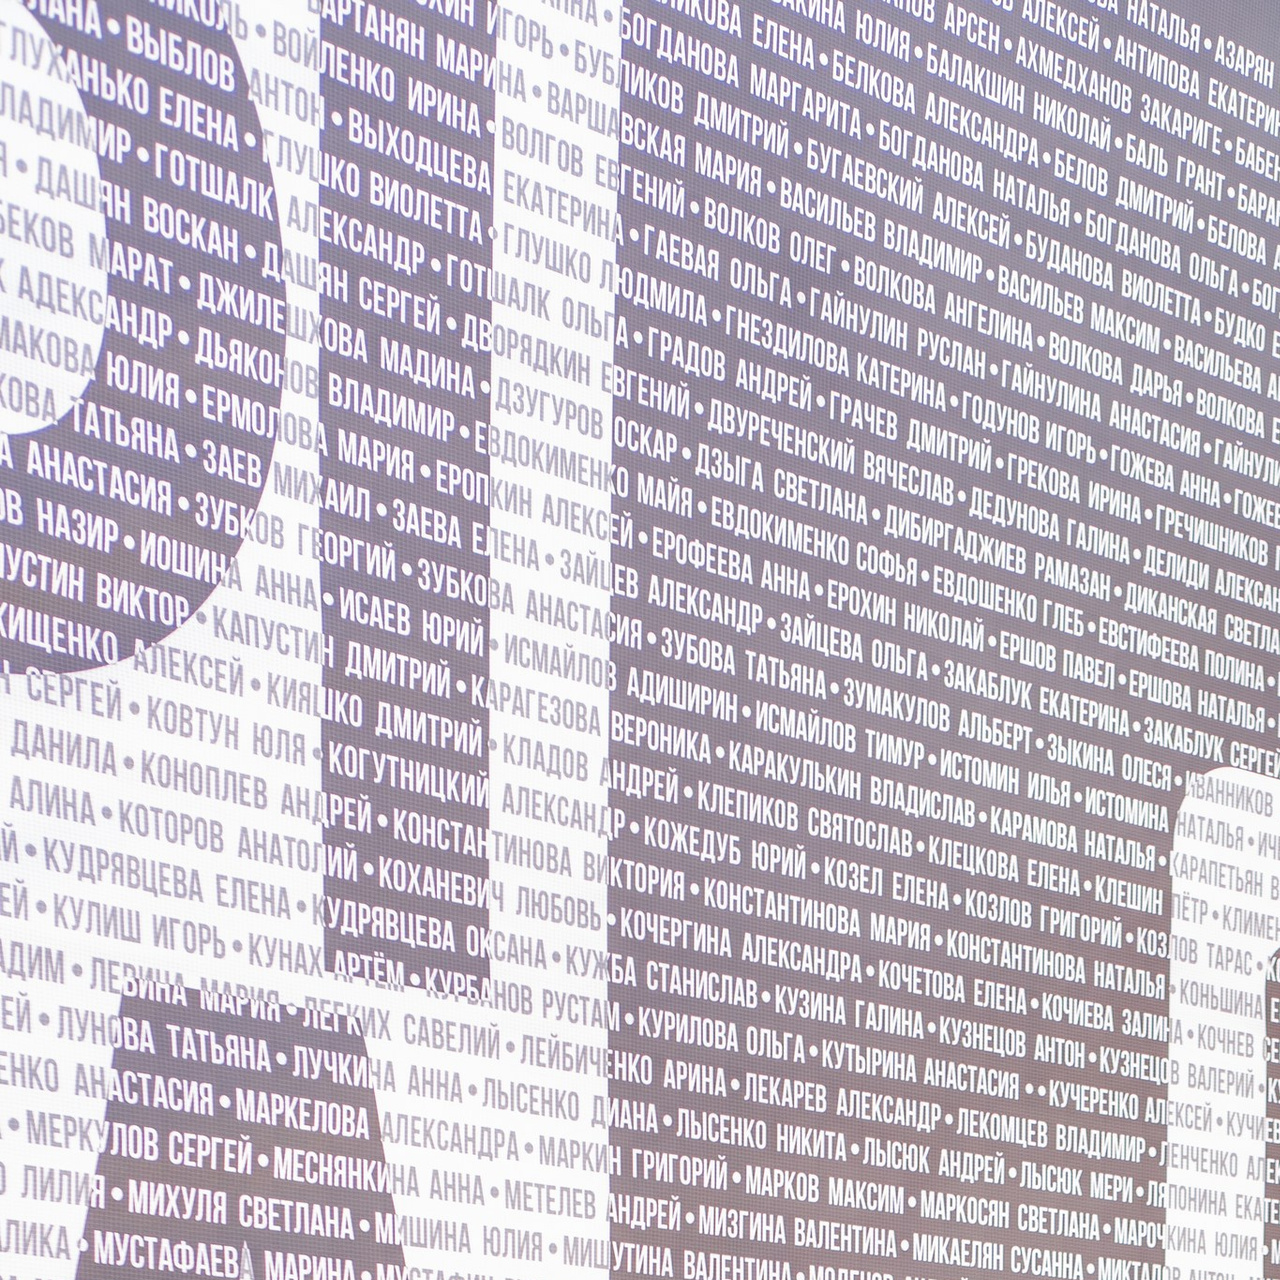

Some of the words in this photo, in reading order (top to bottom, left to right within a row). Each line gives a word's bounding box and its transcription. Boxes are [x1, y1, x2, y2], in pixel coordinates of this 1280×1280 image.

[126, 18, 235, 94] ВЫБЛОВ
[159, 85, 239, 151] ЕЛЕНА
[348, 110, 492, 196] ВЫХОДЦЕВА
[694, 90, 790, 159] ДМИТРИЙ
[806, 138, 924, 214] БУГАЕВСКИЙ
[155, 144, 274, 220] ГОТШАЛК
[370, 172, 483, 244] ВИОЛЕТТА
[1053, 148, 1109, 196] БЕЛОВ
[1115, 178, 1195, 232] ДМИТРИЙ
[144, 196, 239, 263] ВОСКАН
[380, 336, 476, 398] МАДИНА
[647, 328, 726, 382] ГРАДОВ
[735, 358, 813, 413] АНДРЕЙ
[829, 391, 898, 441] ГРАЧЕВ
[906, 419, 992, 474] ДМИТРИЙ
[37, 498, 119, 554] НАЗИР
[339, 587, 411, 638] ИСАЕВ
[422, 604, 484, 657] ЮРИЙ
[147, 696, 239, 751] КОВТУН
[252, 722, 306, 766] ЮЛЯ
[328, 741, 489, 809] КОГУТНИЦКИЙ
[119, 798, 224, 854] КОТОРОВ
[238, 834, 358, 882] АНАТОЛИЙ
[697, 781, 798, 831] КЛЕПИКОВ
[807, 802, 913, 857] СВЯТОСЛАВ
[1177, 811, 1244, 851] НАТАЛЬЯ
[774, 986, 846, 1026] КУЗИНА
[855, 1000, 924, 1039] ГАЛИНА
[939, 1015, 1026, 1058] КУЗНЕЦОВ
[1033, 1031, 1086, 1068] АНТОН
[235, 1088, 370, 1139] МАРКЕЛОВА
[381, 1112, 519, 1162] АЛЕКСАНДРА
[128, 1179, 227, 1225] МИХУЛЯ
[238, 1194, 355, 1241] СВЕТЛАНА
